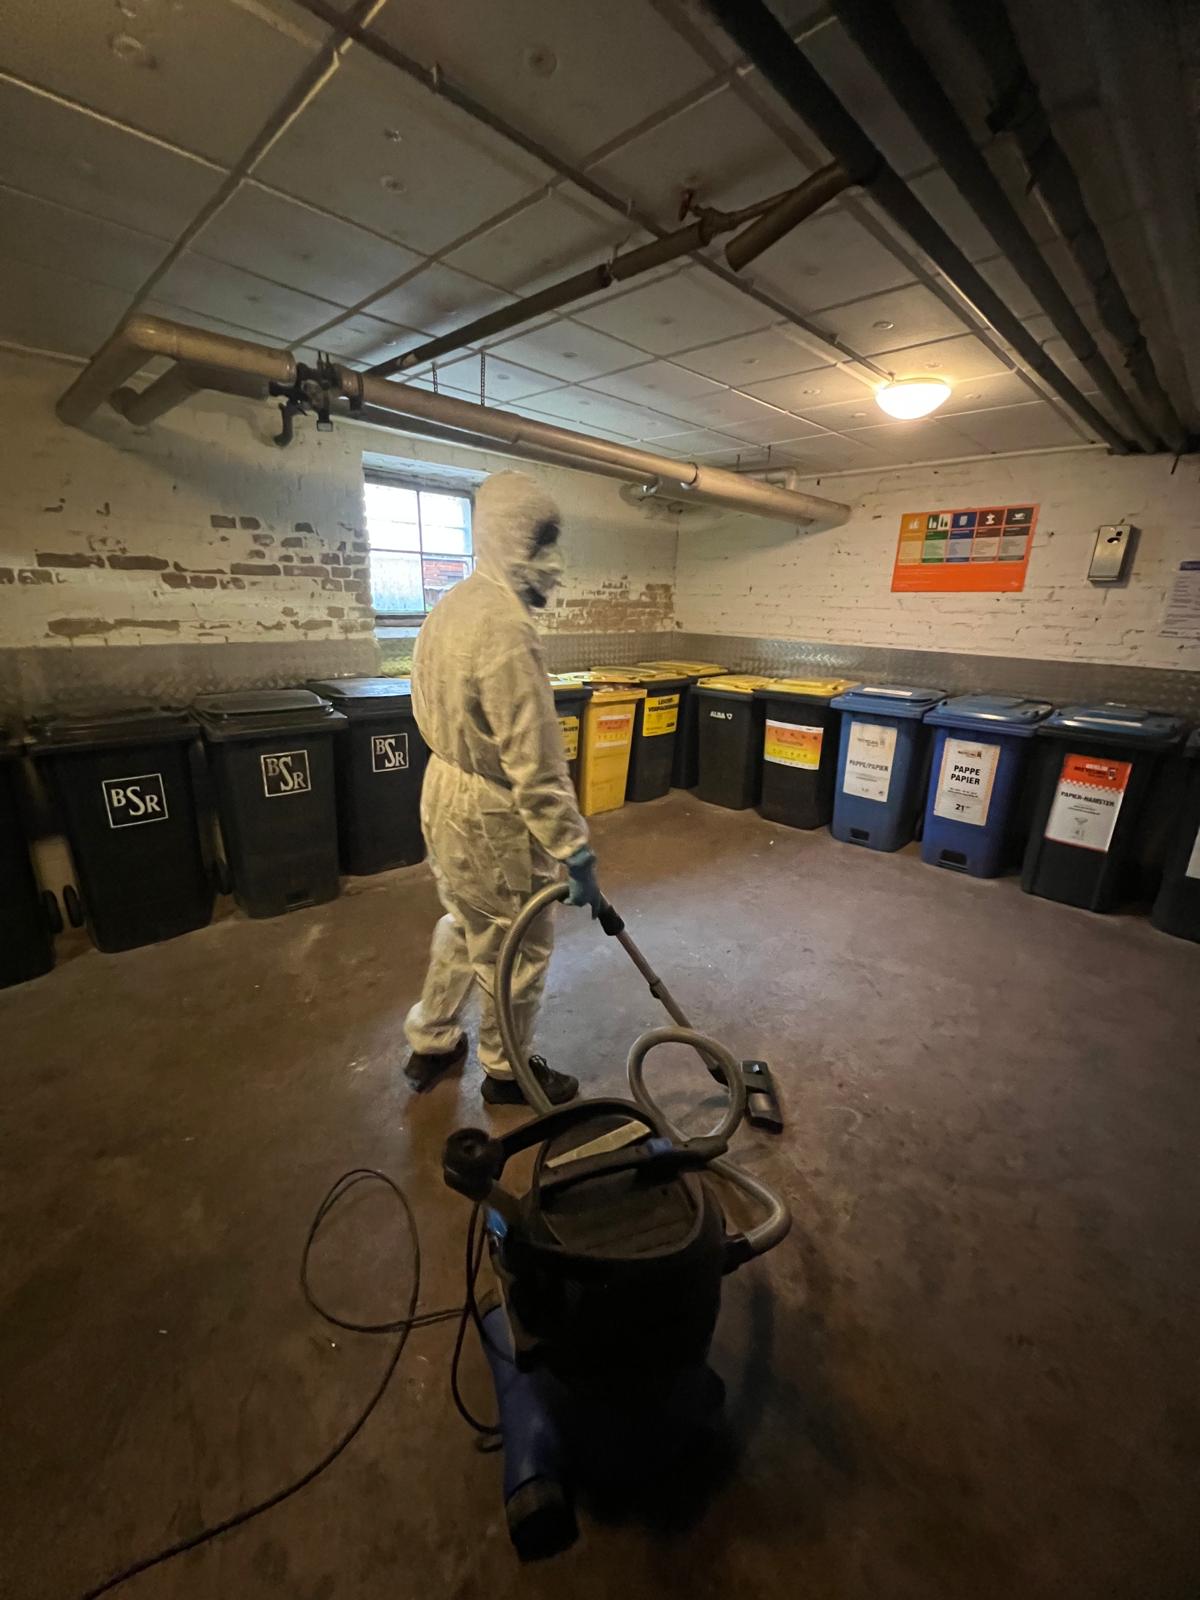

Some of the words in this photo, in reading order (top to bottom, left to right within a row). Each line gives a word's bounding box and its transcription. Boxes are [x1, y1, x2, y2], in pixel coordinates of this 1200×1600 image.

[375, 737, 405, 768] BSR
[266, 756, 306, 792] BSR
[950, 773, 981, 785] PAPIER
[953, 764, 981, 776] PAPPE
[112, 785, 162, 816] BSR
